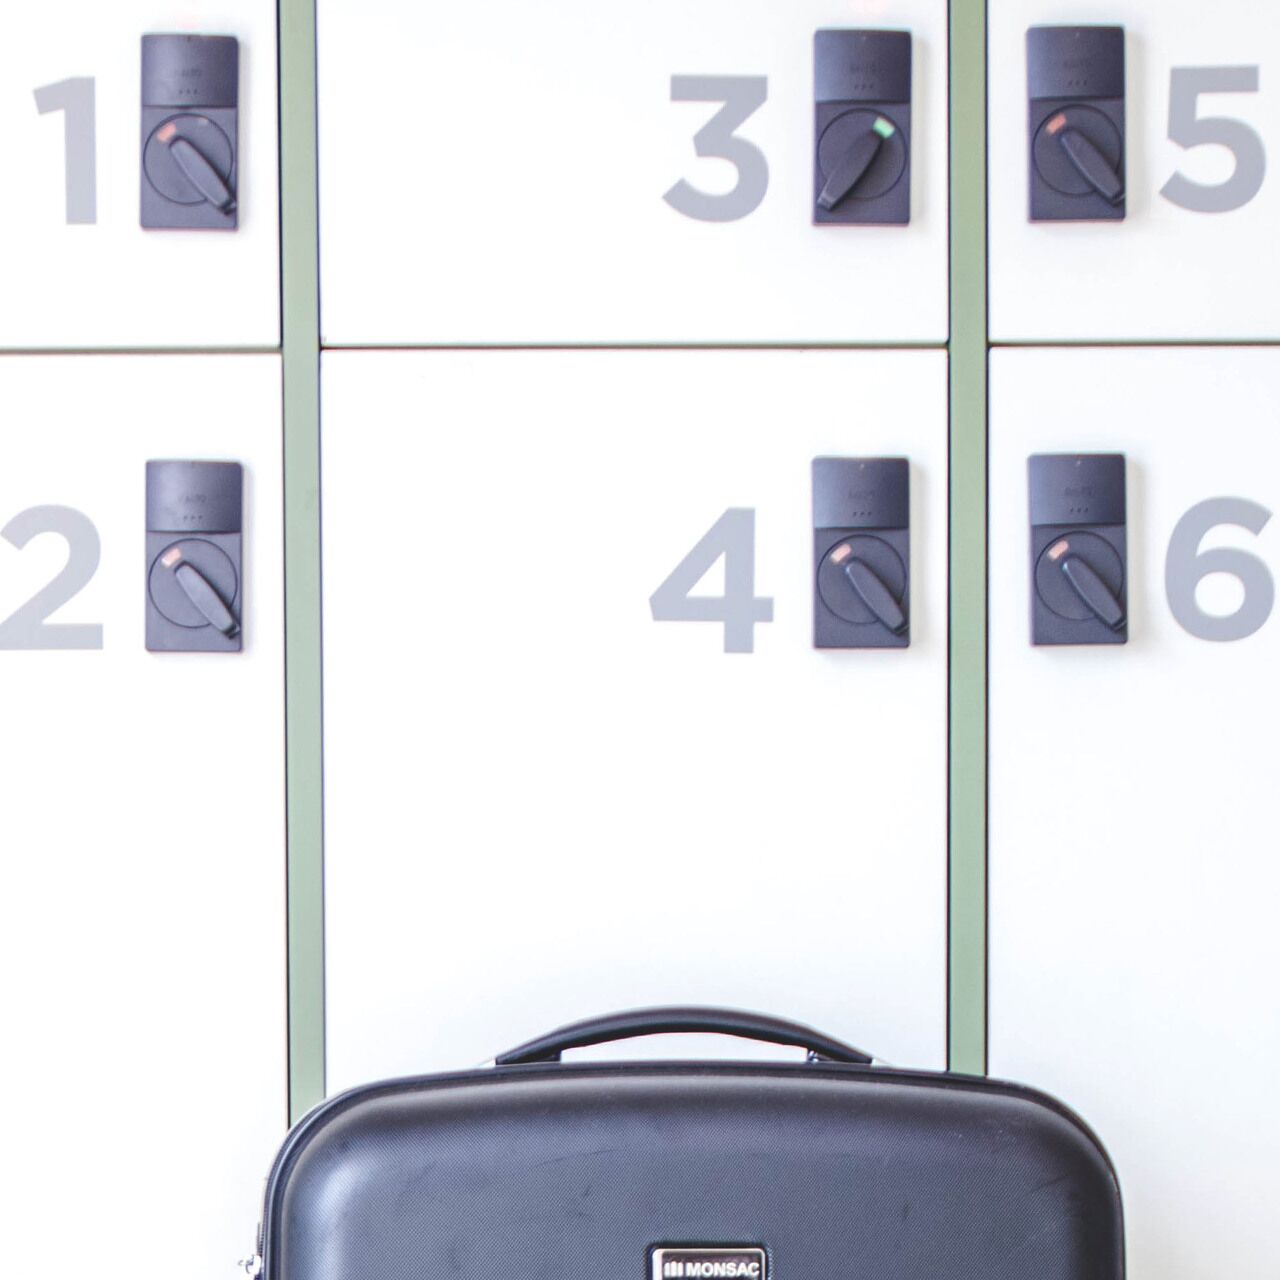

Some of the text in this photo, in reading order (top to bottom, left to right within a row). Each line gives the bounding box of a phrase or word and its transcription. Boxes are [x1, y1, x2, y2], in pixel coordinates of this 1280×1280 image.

[33, 77, 98, 225] 1
[662, 75, 770, 222] 3
[1159, 66, 1267, 214] 5
[649, 508, 774, 654] 4
[1164, 497, 1275, 643] 6
[686, 1262, 760, 1277] MONSAC
